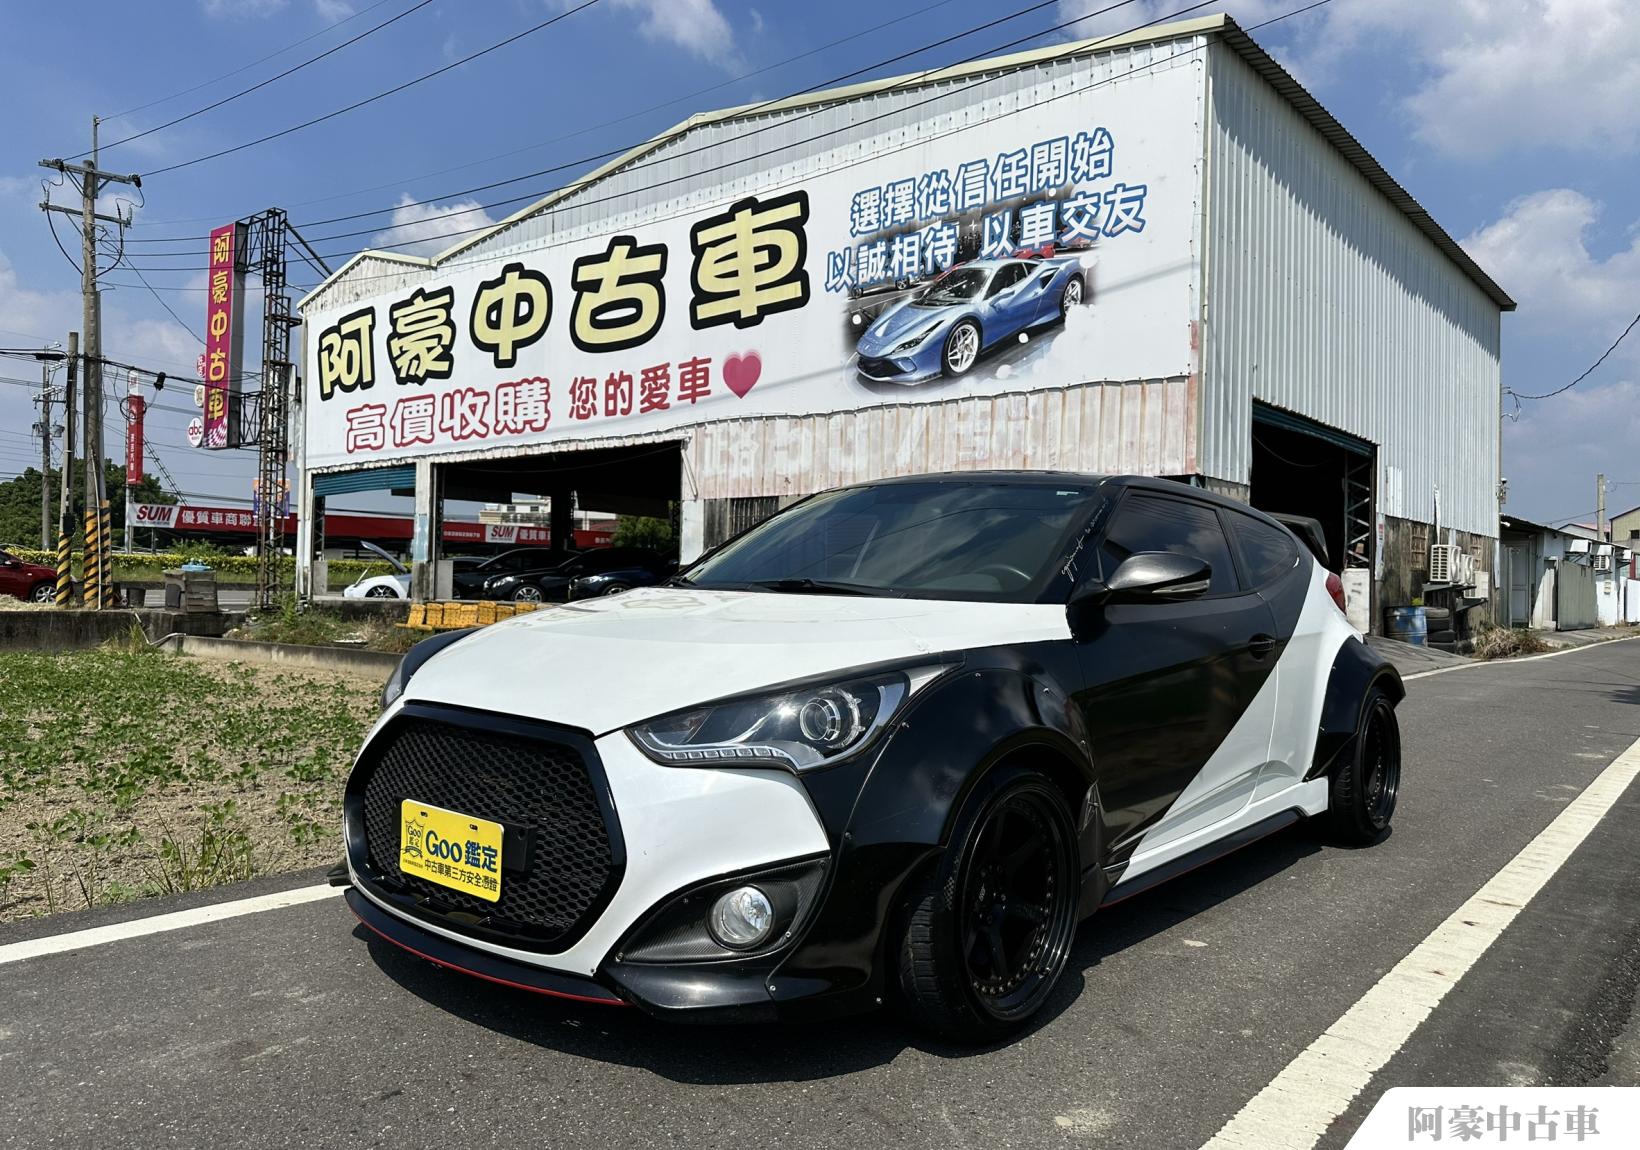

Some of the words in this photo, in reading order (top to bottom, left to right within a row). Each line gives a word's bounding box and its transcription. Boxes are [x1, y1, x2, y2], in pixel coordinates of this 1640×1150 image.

[850, 127, 1115, 237] 選擇從信任開始
[825, 222, 960, 293] 以誠相待
[981, 182, 1148, 260] 以車交友
[207, 231, 231, 421] 阿豪中古車
[318, 190, 811, 400] 阿豪中古車
[188, 420, 203, 436] abc
[346, 376, 552, 453] 高價收購
[568, 356, 713, 421] 您的愛車
[136, 505, 173, 522] SUM
[491, 525, 515, 538] SUM
[425, 830, 463, 864] Goo
[464, 839, 498, 874] 鑑定
